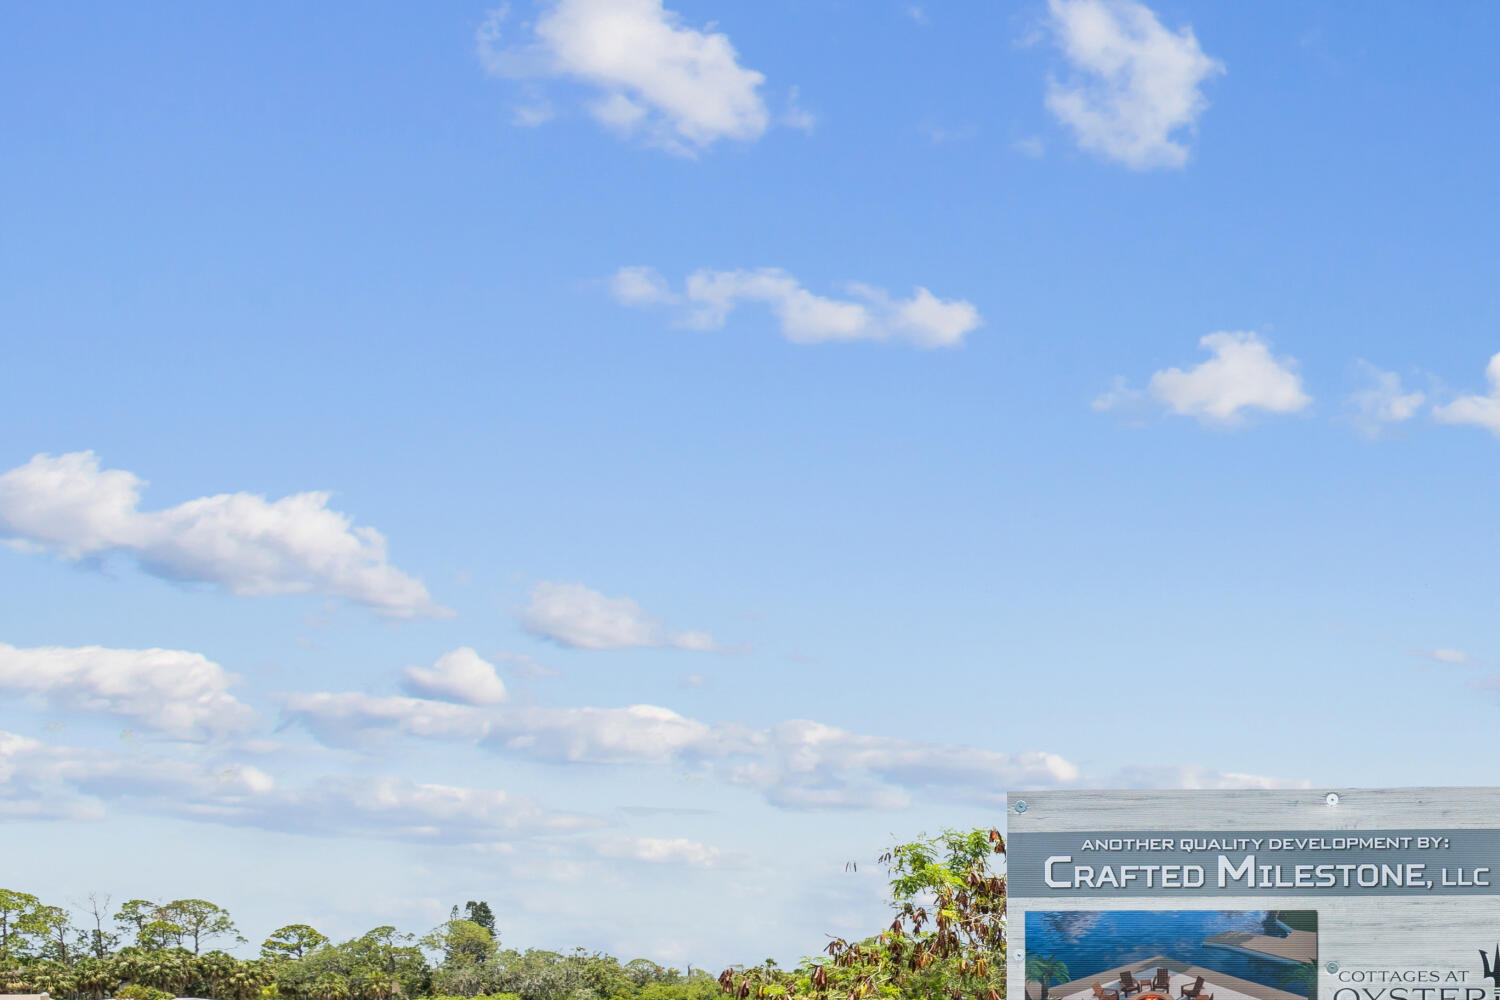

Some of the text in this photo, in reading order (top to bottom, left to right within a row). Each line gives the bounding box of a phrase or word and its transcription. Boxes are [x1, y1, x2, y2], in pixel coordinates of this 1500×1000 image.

[1081, 836, 1449, 853] ANOTHER QUALITY DEVELOPMENT BY:
[1044, 854, 1489, 889] CRAFTED MILESTONE, LLC
[1338, 970, 1469, 983] COTTAGES AT
